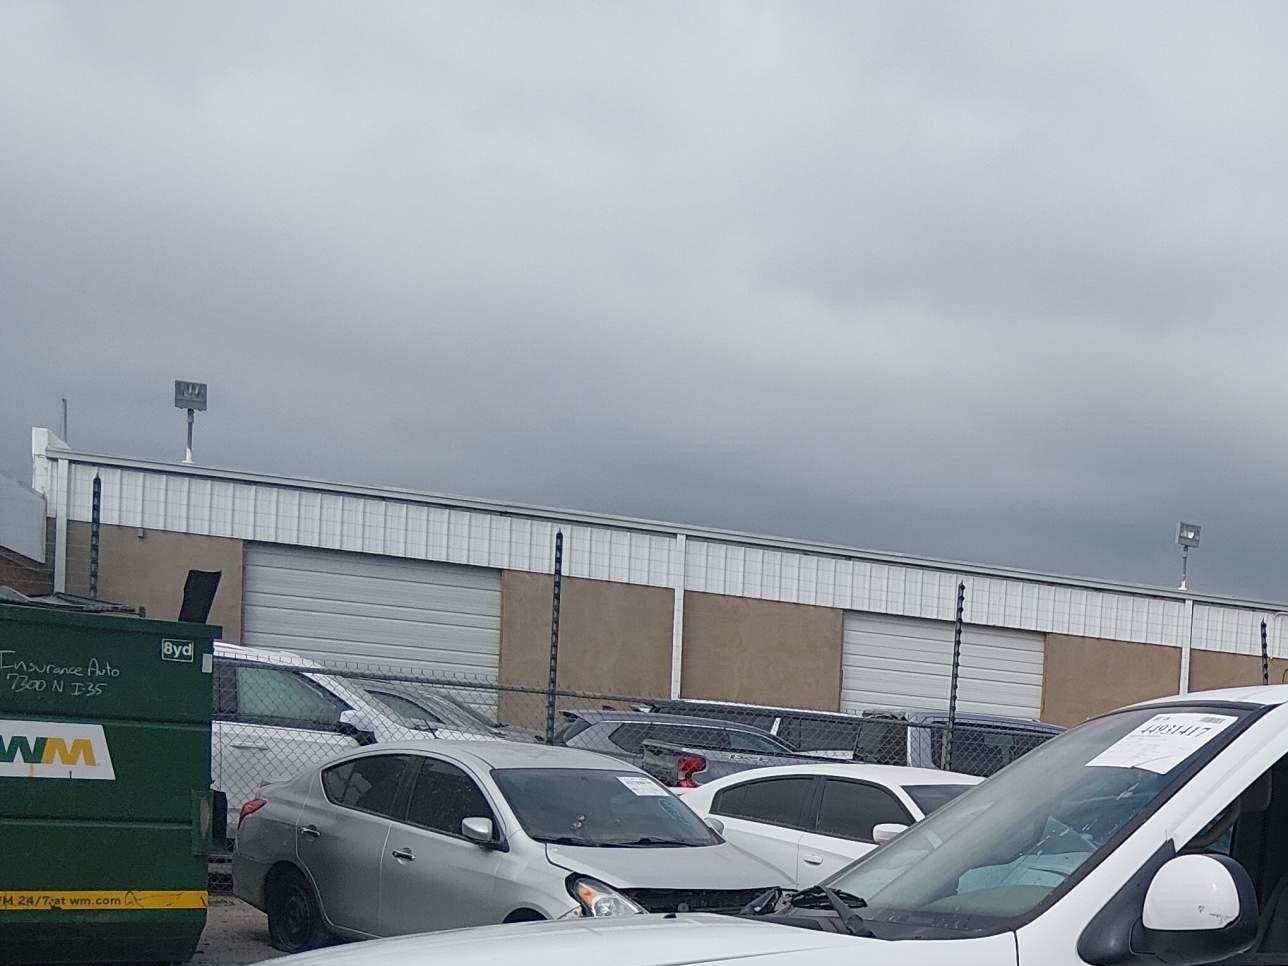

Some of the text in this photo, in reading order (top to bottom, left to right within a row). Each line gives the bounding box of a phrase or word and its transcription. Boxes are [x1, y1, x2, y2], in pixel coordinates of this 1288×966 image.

[164, 641, 192, 658] 8yd
[0, 650, 120, 677] Insurance Auto
[6, 673, 47, 692] 7300
[52, 679, 64, 692] N
[1141, 724, 1213, 738] 44931417
[0, 735, 97, 766] WM
[0, 895, 13, 905] M
[70, 896, 121, 906] wm.com
